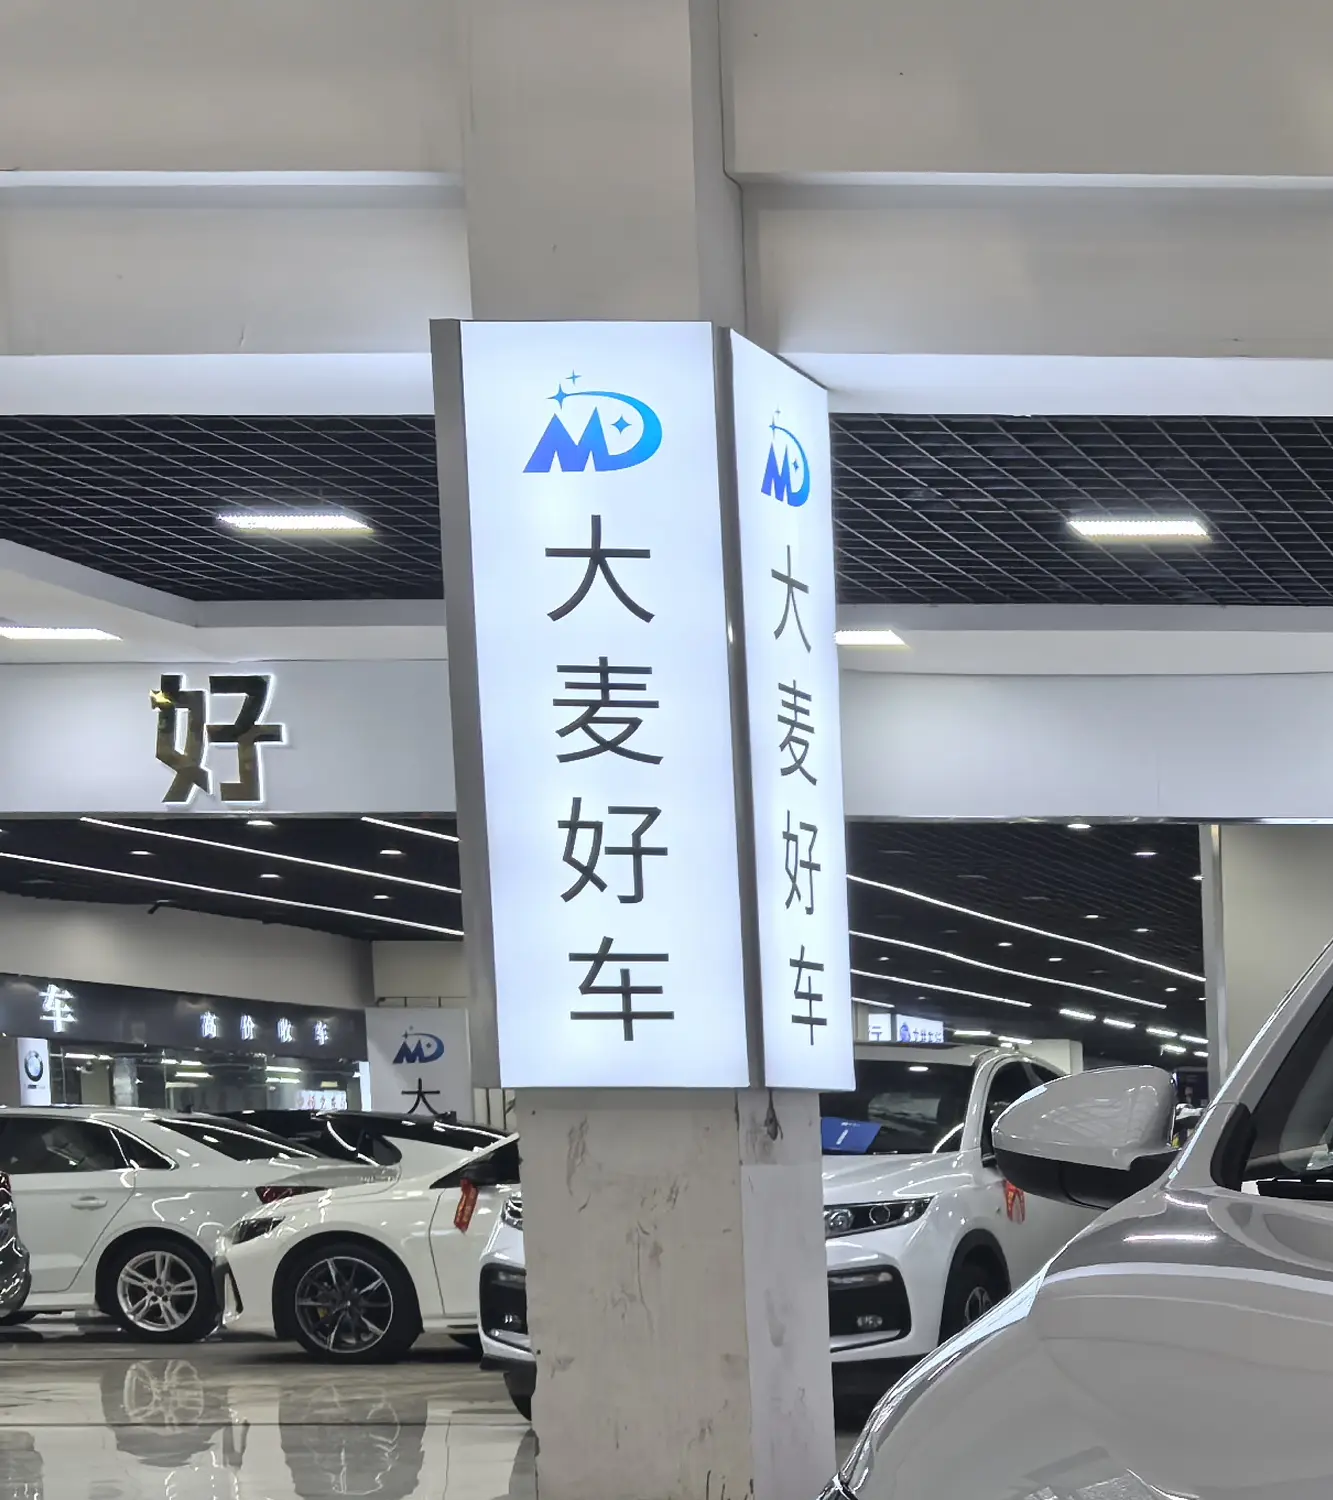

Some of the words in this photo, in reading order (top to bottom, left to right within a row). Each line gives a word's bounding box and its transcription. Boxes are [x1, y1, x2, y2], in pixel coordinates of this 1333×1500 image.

[150, 672, 284, 804] 好
[545, 514, 675, 1043] 大麦好车
[770, 544, 828, 1046] 大麦好车
